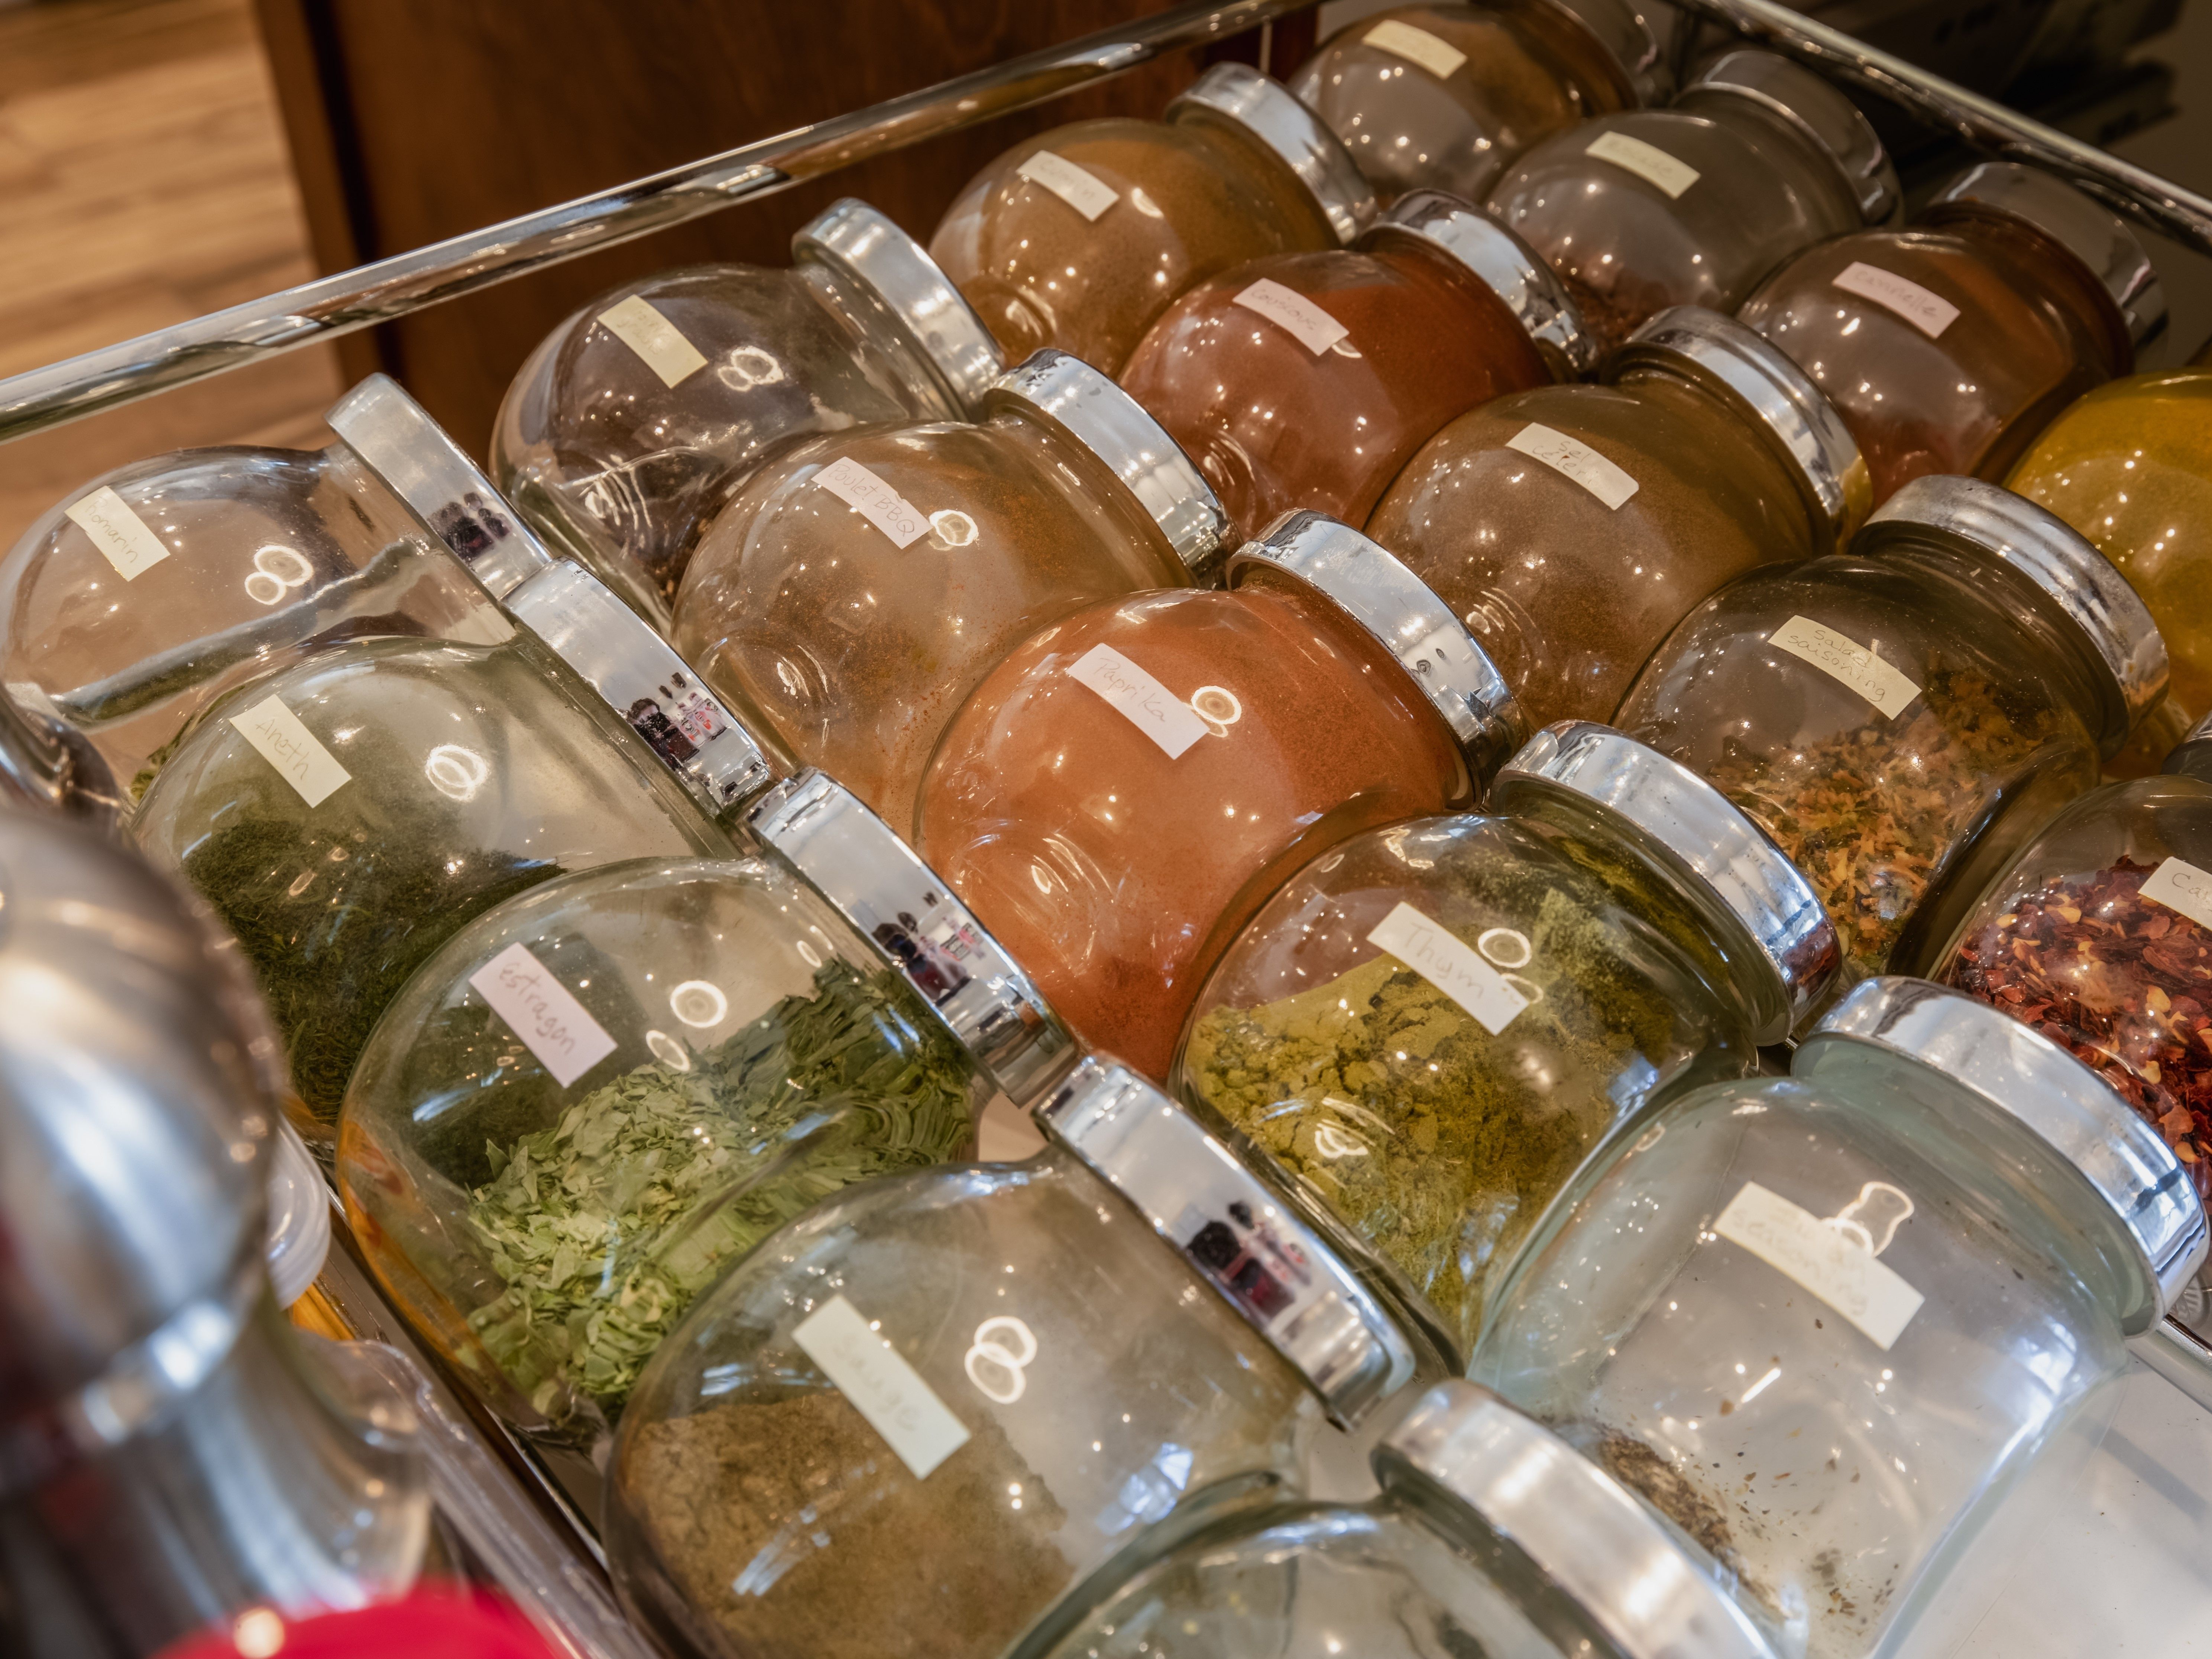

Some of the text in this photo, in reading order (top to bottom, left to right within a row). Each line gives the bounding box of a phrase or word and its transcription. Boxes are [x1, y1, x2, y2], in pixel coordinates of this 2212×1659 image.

[1559, 440, 1591, 462] Sel
[827, 464, 916, 538] Poulet BBQ
[255, 718, 310, 781] Aneth
[1404, 921, 1485, 999] Thym
[831, 1333, 923, 1433] Sauge
